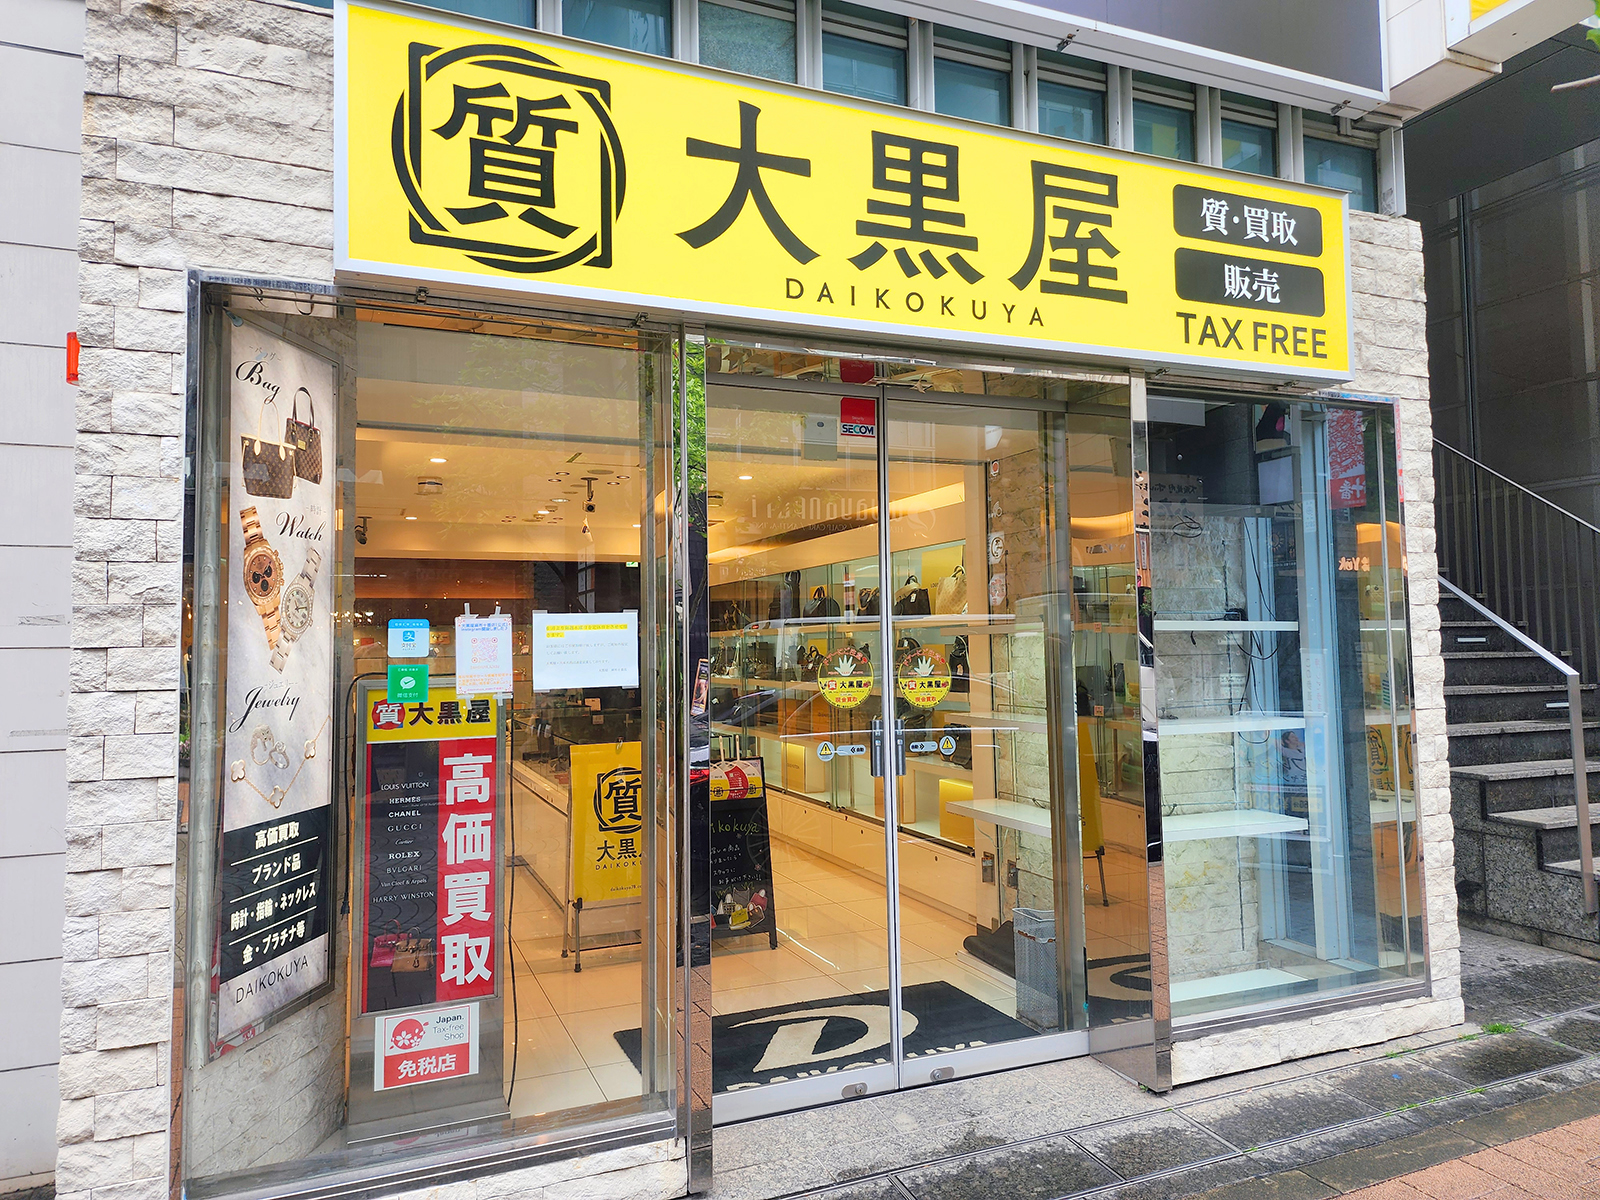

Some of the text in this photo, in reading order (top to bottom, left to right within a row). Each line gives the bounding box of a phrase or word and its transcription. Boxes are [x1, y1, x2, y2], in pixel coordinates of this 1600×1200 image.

[431, 81, 579, 239] 質
[675, 100, 1128, 304] 大黒屋
[1223, 262, 1281, 304] 販売
[786, 278, 1045, 327] DAIKOKUYA
[1176, 311, 1328, 360] TAX FREE
[235, 360, 281, 405] Bag
[842, 424, 874, 435] SECOM
[275, 511, 327, 542] Watch
[839, 680, 863, 689] 大黒屋
[919, 681, 941, 689] 大黒屋
[229, 685, 301, 734] Jewelry
[376, 700, 491, 726] 質 大黒屋
[401, 781, 429, 790] VUITTON
[388, 810, 421, 818] CHANEL
[604, 777, 642, 824] 質
[255, 821, 300, 850] 高価買取
[387, 824, 422, 832] GUCCI
[252, 853, 301, 884] ブランド品
[388, 850, 421, 860] ROLEX
[442, 753, 493, 985] 高価買取
[386, 865, 422, 874] BVLGARI
[373, 891, 434, 904] HARRY WINSTON
[235, 955, 309, 1004] DAIKOKUYA
[432, 1023, 465, 1034] Tax-free
[443, 1031, 465, 1041] Shop
[397, 1053, 457, 1080] 免税店
